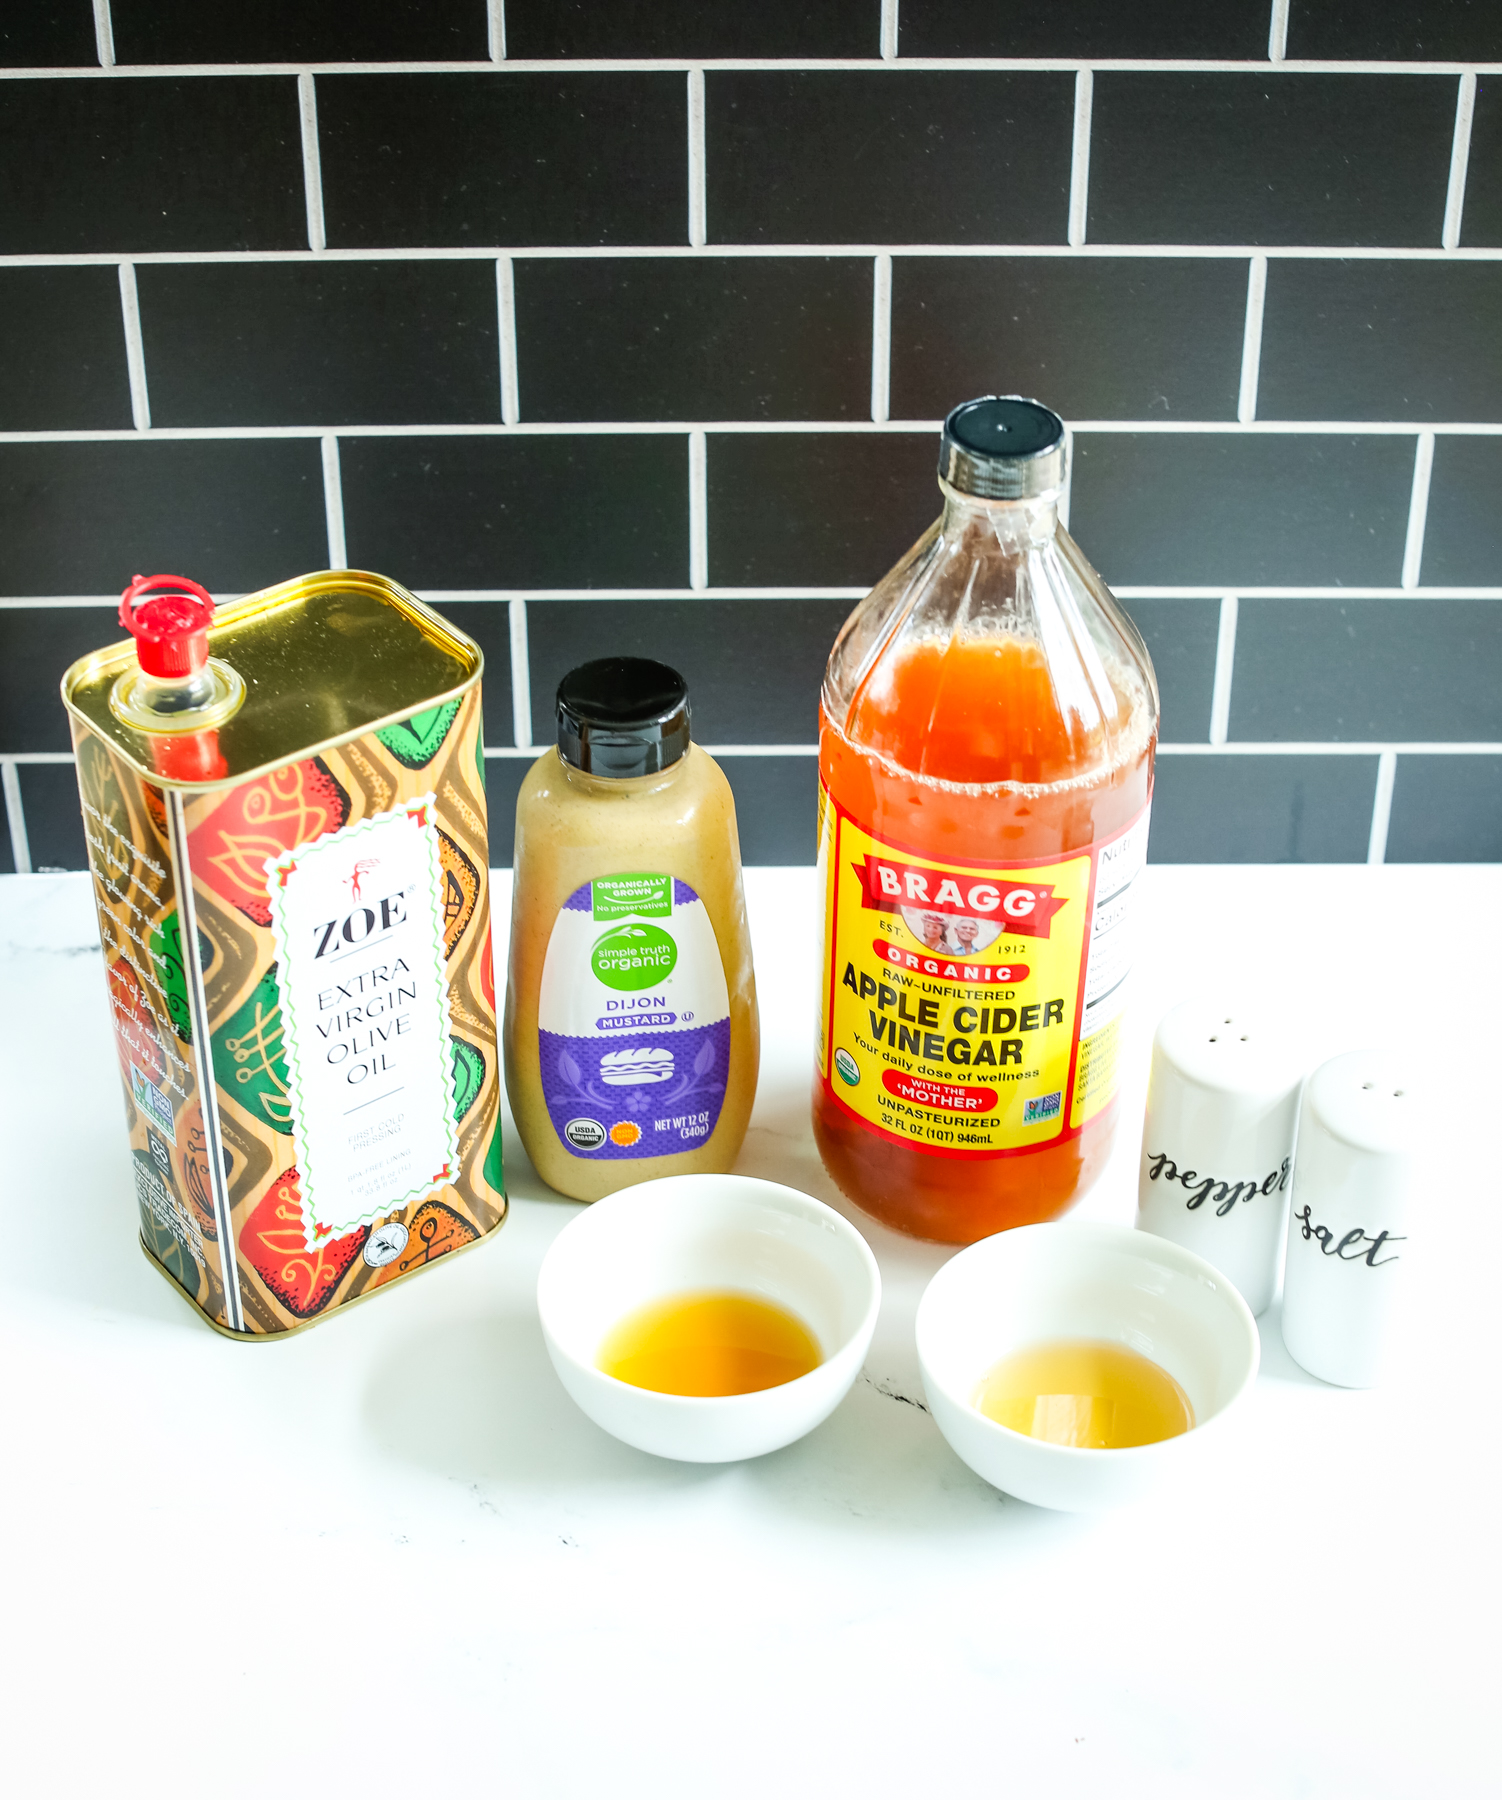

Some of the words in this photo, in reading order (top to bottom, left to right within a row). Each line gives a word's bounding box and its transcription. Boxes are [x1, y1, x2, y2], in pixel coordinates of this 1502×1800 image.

[103, 813, 119, 837] the
[120, 834, 167, 878] exquisite
[106, 845, 130, 876] fruit
[596, 877, 667, 890] ORGANICALLY
[612, 887, 652, 897] GROWN
[877, 865, 1036, 917] BRAGG
[106, 879, 142, 921] glowing
[144, 914, 165, 939] rich
[610, 901, 669, 913] preservatives
[97, 897, 121, 926] green
[123, 923, 146, 950] color
[147, 947, 167, 970] and
[313, 891, 407, 960] ZOE
[879, 919, 904, 939] EST.
[997, 943, 1026, 955] 1912
[103, 927, 118, 950] the
[119, 945, 168, 999] distinctive
[598, 947, 637, 959] simple
[640, 944, 671, 955] truth
[598, 953, 671, 971] organic
[887, 946, 1012, 981] ORGANIC
[318, 958, 411, 1011] EXTRA
[842, 962, 940, 1029] APPLE
[953, 998, 1065, 1034] CIDER
[128, 984, 138, 1002] of
[157, 1013, 169, 1028] as
[170, 1023, 180, 1037] it
[316, 981, 417, 1038] VIRGIN
[602, 1014, 671, 1028] MUSTARD
[606, 996, 666, 1011] DIJON
[121, 1024, 140, 1052] that
[141, 1048, 149, 1061] it
[145, 1028, 191, 1073] enhances
[327, 1013, 412, 1064] OLIVE
[868, 1008, 1023, 1067] VINEGAR
[347, 1053, 397, 1085] OIL
[853, 1031, 878, 1056] Your
[881, 1052, 913, 1071] daily
[917, 1064, 953, 1080] dose
[957, 1072, 972, 1082] of
[977, 1068, 1040, 1083] wellness
[910, 1078, 941, 1093] WITH
[943, 1086, 966, 1097] THE
[348, 1126, 374, 1145] FIRST
[378, 1112, 405, 1131] COLD
[654, 1119, 671, 1131] NET
[672, 1116, 686, 1129] WT
[688, 1115, 697, 1126] 12
[698, 1111, 709, 1124] OZ
[877, 1094, 1001, 1128] UNPASTEURIZED
[881, 1112, 893, 1126] 32
[895, 1118, 907, 1131] FL
[909, 1123, 923, 1136] OZ
[926, 1127, 955, 1143] (1QT)
[957, 1133, 993, 1144] 946mL
[353, 1124, 402, 1152] PRESSING
[572, 1134, 599, 1142] ORGANIC
[574, 1126, 596, 1134] USDA
[680, 1123, 710, 1139] (340g)
[386, 1148, 411, 1165] LINING
[1147, 1153, 1291, 1217] pepper
[165, 1190, 176, 1207] OF
[177, 1201, 202, 1234] SPAIN
[1293, 1204, 1407, 1267] salt
